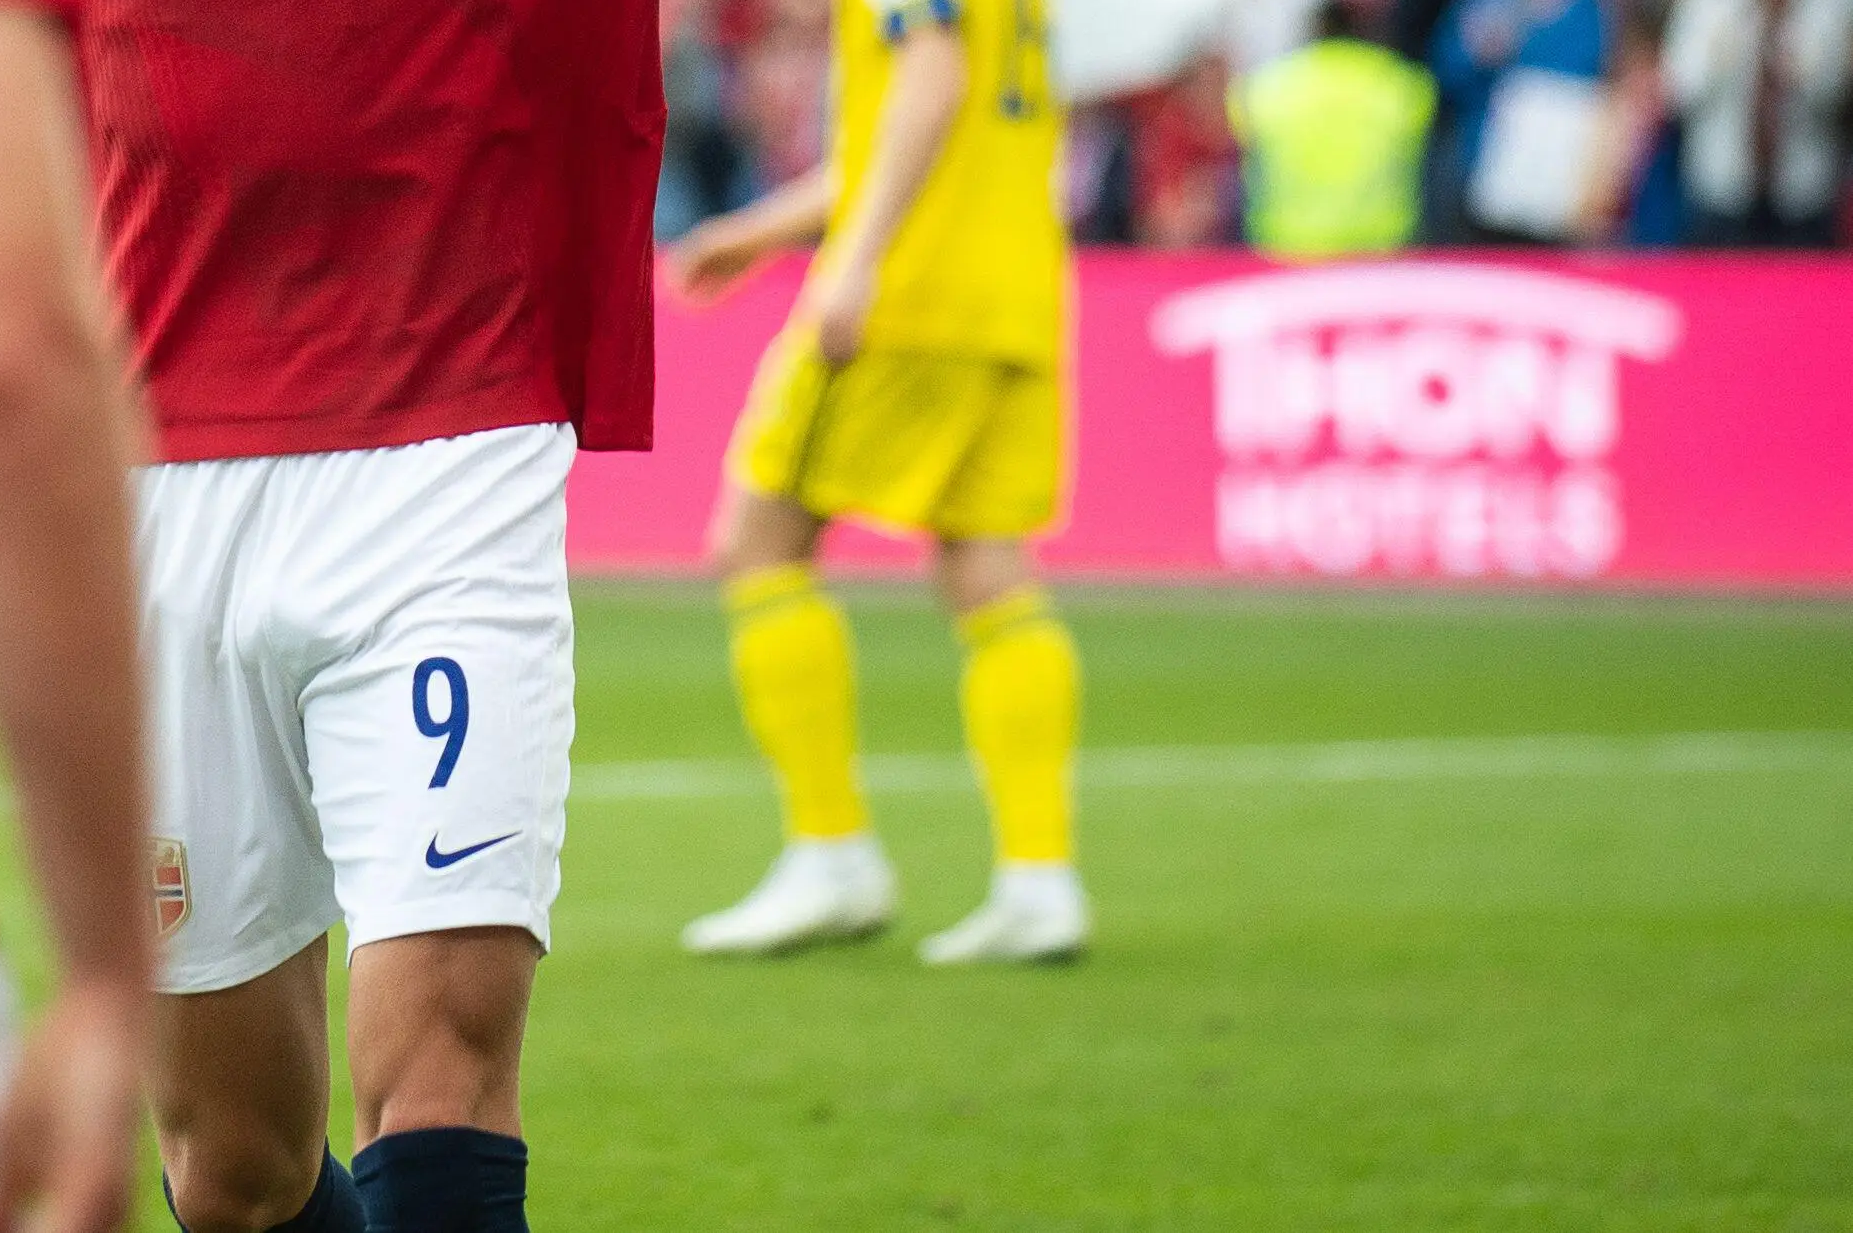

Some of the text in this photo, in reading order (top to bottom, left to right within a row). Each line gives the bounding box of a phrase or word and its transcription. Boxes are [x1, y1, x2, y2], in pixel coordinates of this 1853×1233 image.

[1158, 270, 1678, 457] THON
[1216, 469, 1621, 573] HOTELS
[412, 656, 469, 789] 9
